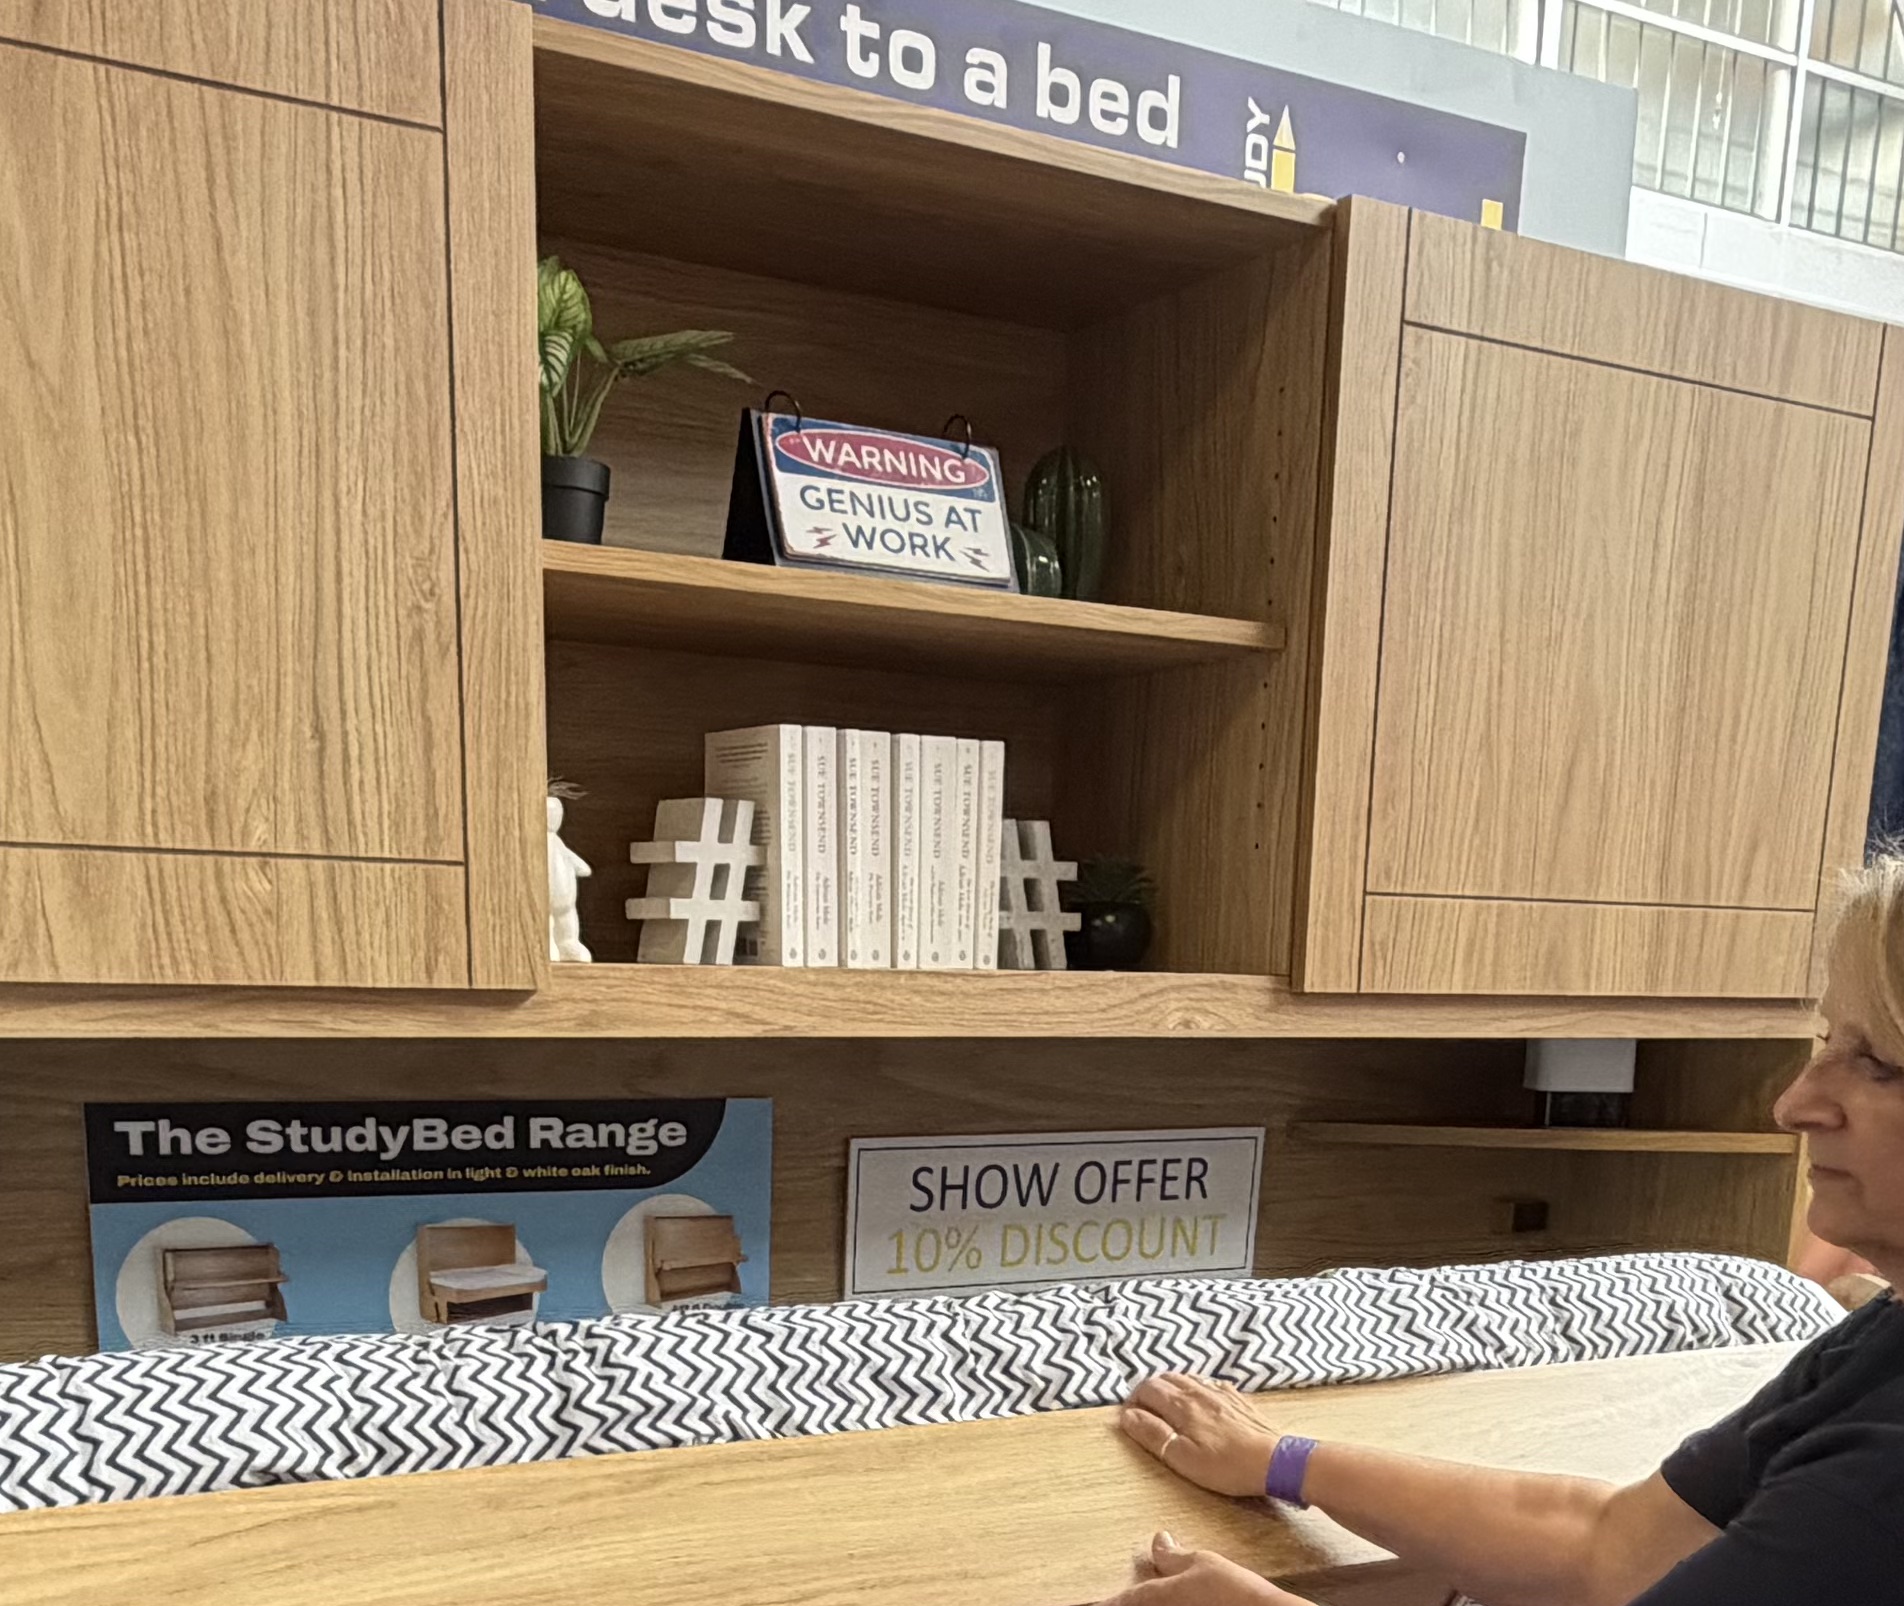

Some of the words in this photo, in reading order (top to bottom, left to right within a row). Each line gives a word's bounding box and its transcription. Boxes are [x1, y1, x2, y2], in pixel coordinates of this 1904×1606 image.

[840, 4, 936, 90] to
[964, 47, 1007, 109] a
[1036, 41, 1180, 149] bed
[802, 436, 966, 484] WARNING
[799, 485, 933, 526] GENIUS
[945, 505, 982, 533] AT
[842, 522, 956, 562] WORK
[817, 783, 827, 855] TOWNSEND
[870, 786, 881, 857] TOWNSEND
[114, 1120, 232, 1157] The
[245, 1115, 516, 1161] StudyBed
[529, 1117, 688, 1155] Range
[117, 1174, 178, 1188] Prices
[182, 1171, 250, 1186] include
[253, 1170, 325, 1186] delivery
[447, 1167, 463, 1180] in
[465, 1166, 502, 1182] light
[523, 1165, 569, 1178] white
[572, 1165, 600, 1178] oak
[604, 1164, 651, 1177] finish.
[910, 1162, 1060, 1212] SHOW
[1073, 1157, 1210, 1204] OFFER
[886, 1226, 982, 1274] 10%
[1000, 1214, 1227, 1268] DISCOUNT
